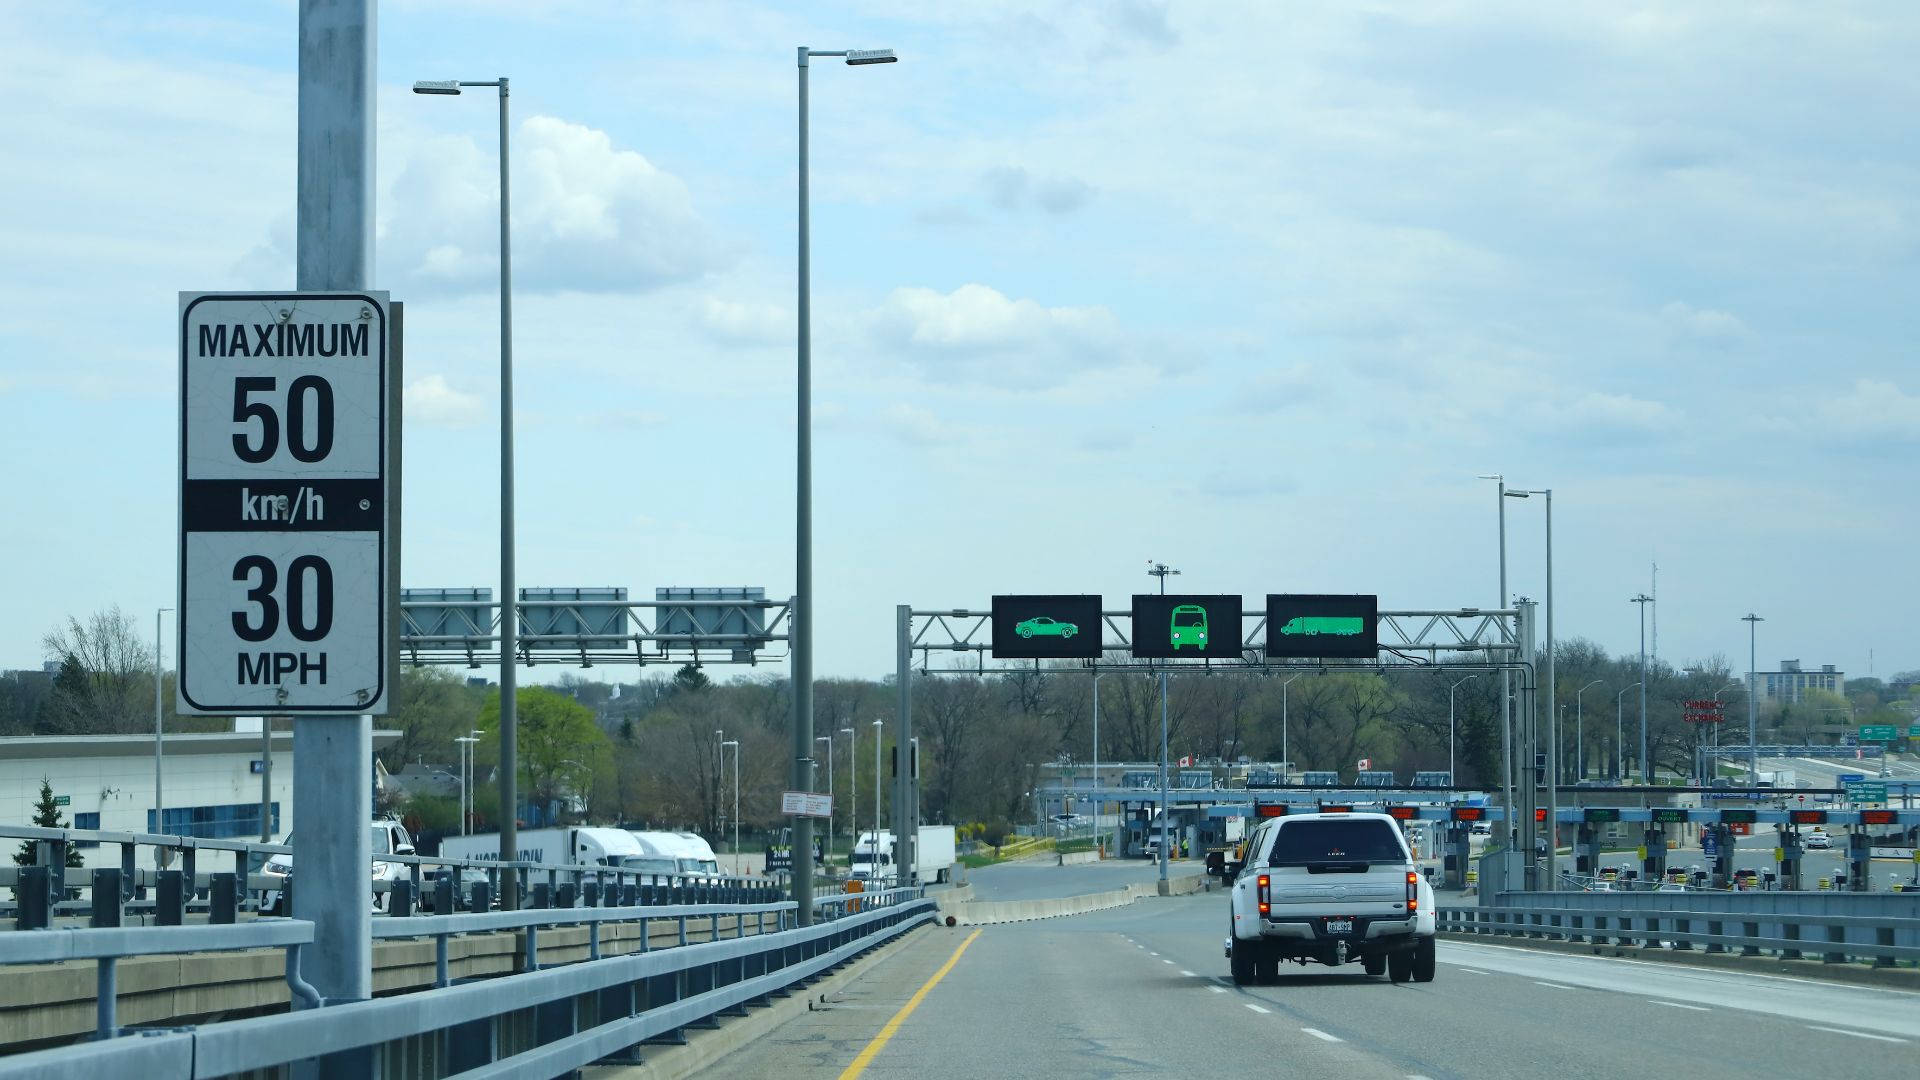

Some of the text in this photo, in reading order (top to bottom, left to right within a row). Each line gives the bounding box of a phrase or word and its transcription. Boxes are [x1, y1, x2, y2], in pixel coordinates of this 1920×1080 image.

[198, 323, 369, 358] MAXIMUM
[231, 374, 335, 464] 50
[241, 486, 325, 524] km/h
[231, 554, 335, 643] 30
[237, 651, 328, 685] MPH
[1684, 700, 1724, 709] CURRENCY
